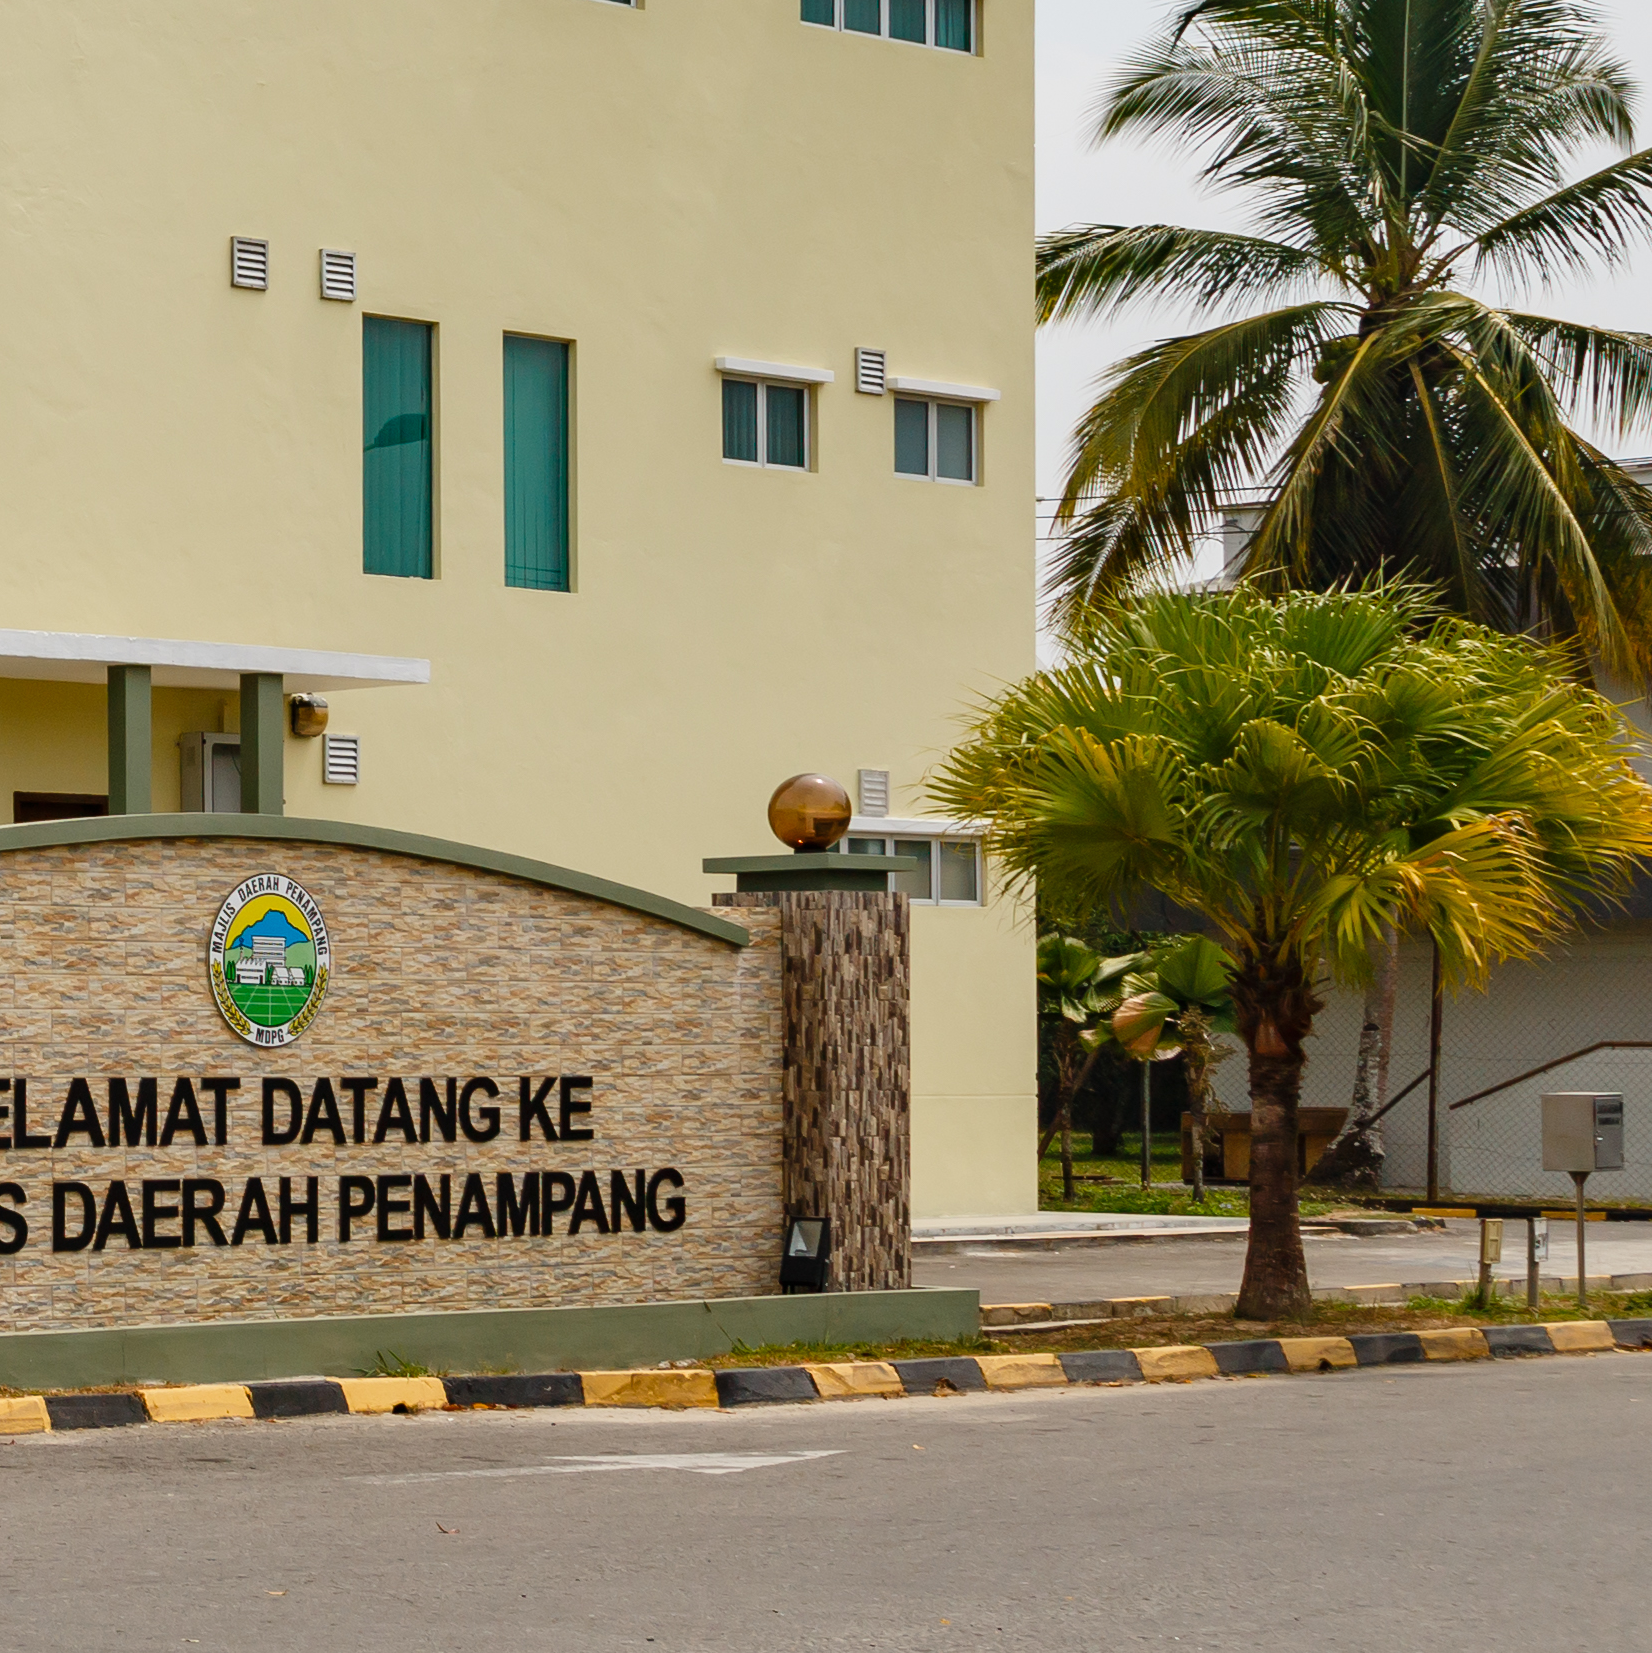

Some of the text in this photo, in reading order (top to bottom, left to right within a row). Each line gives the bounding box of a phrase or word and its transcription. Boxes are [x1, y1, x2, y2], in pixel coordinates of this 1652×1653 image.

[212, 876, 328, 956] MAJLIS DAERAH PENAMPANG
[255, 1027, 285, 1045] MDPG
[260, 1075, 501, 1146] DATANG
[518, 1075, 595, 1143] KE
[51, 1175, 320, 1253] DAERAH
[338, 1166, 687, 1244] PENAMPANG
